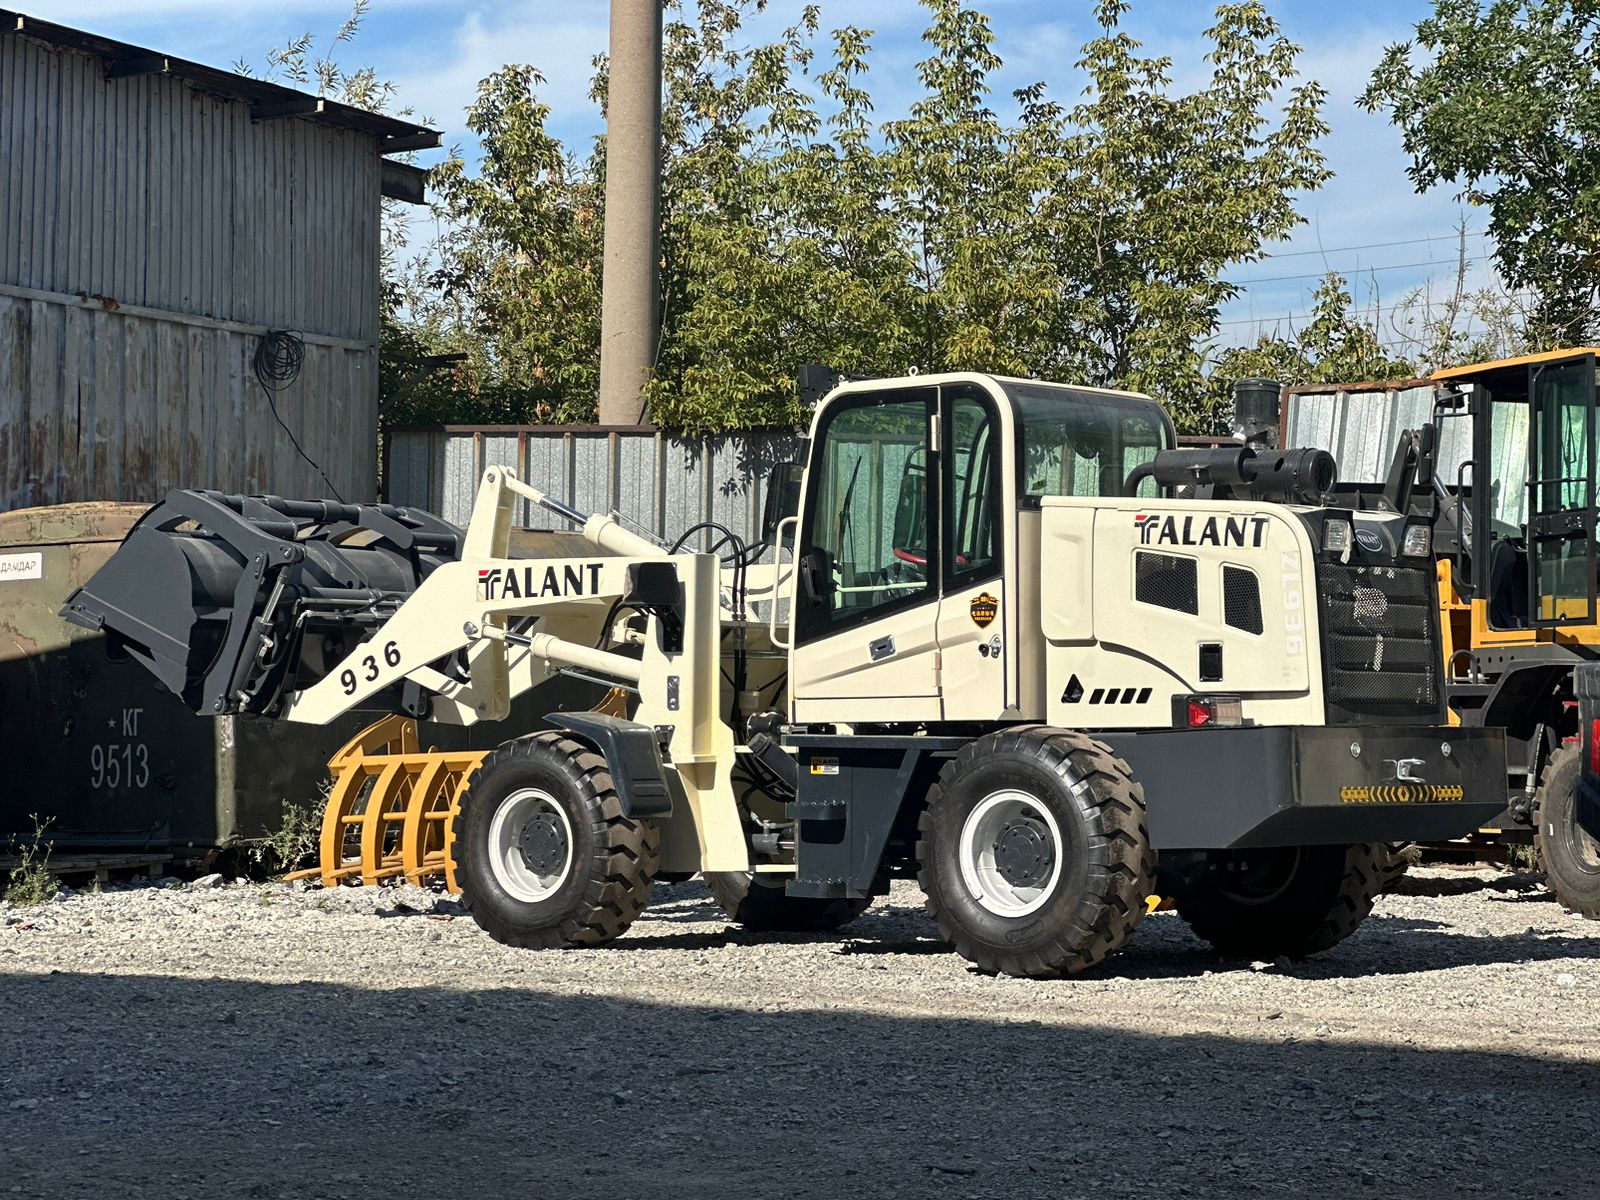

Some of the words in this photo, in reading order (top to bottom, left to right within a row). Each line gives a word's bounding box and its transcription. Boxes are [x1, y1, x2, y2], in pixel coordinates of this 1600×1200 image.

[1134, 515, 1269, 547] TALANT
[478, 563, 604, 600] TALANT
[340, 640, 401, 696] 936
[123, 708, 143, 736] КГ
[91, 744, 149, 789] 9513
